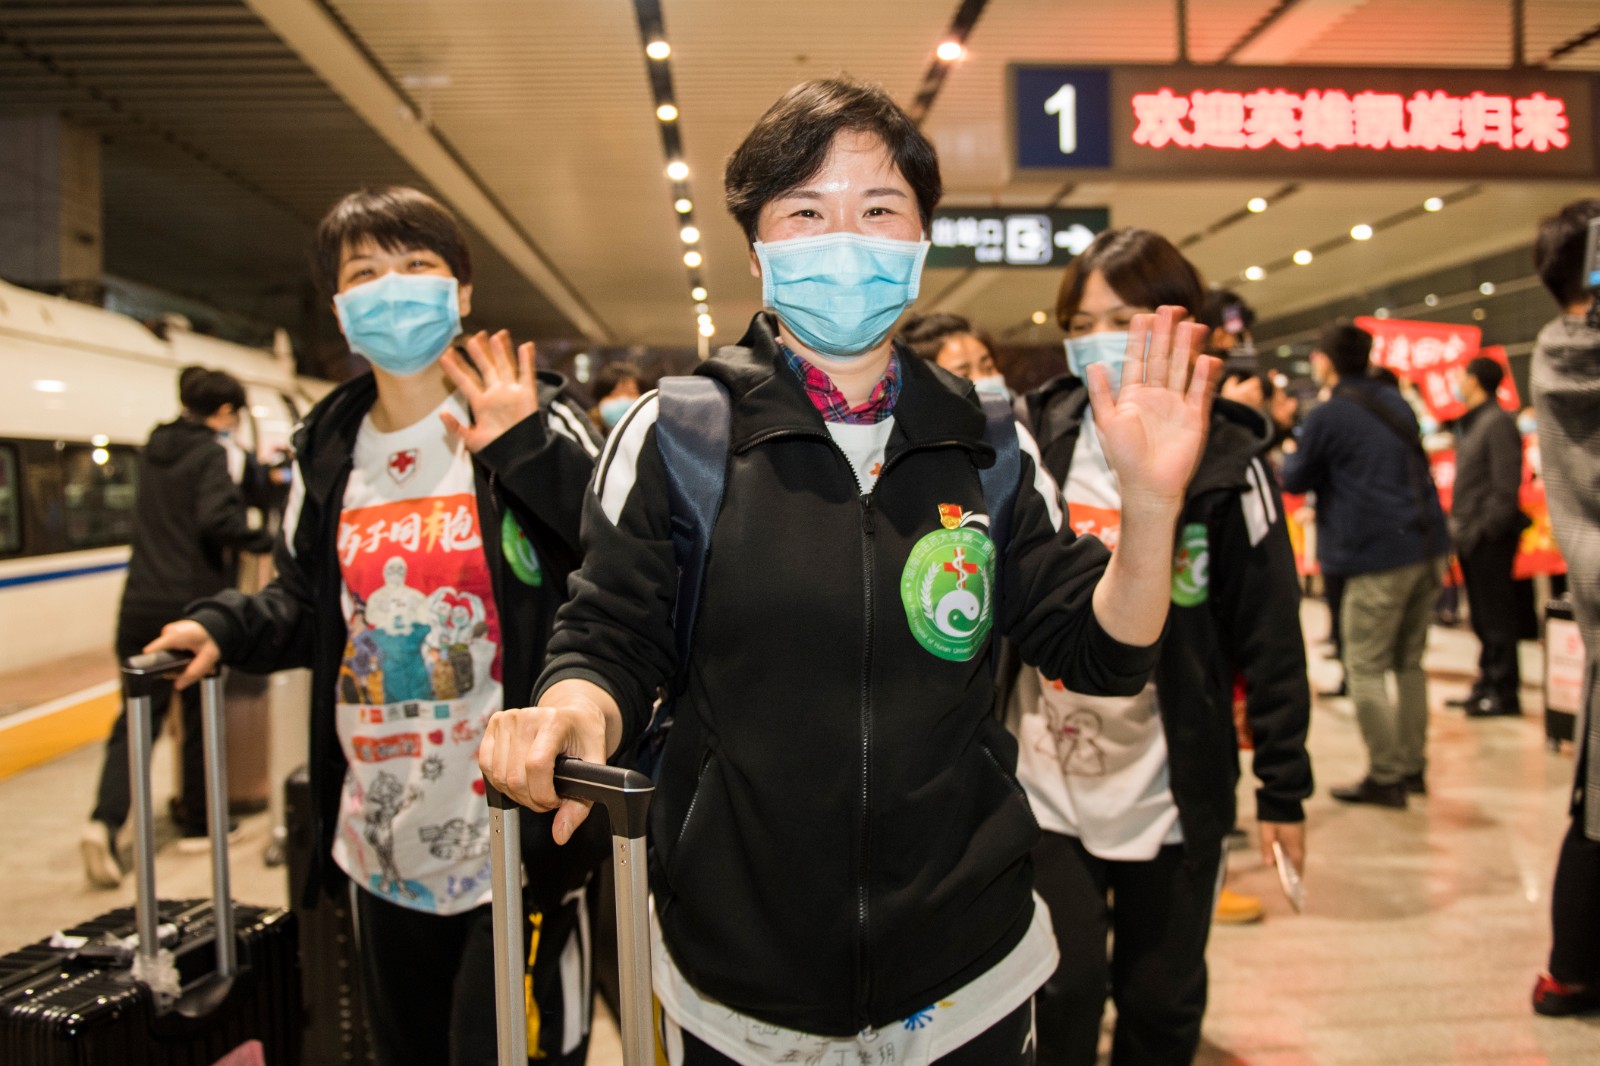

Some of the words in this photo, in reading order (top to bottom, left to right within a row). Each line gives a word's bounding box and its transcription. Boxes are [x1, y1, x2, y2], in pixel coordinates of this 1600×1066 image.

[1042, 83, 1077, 155] 1
[1132, 87, 1569, 152] 欢迎英雄凯旋归来
